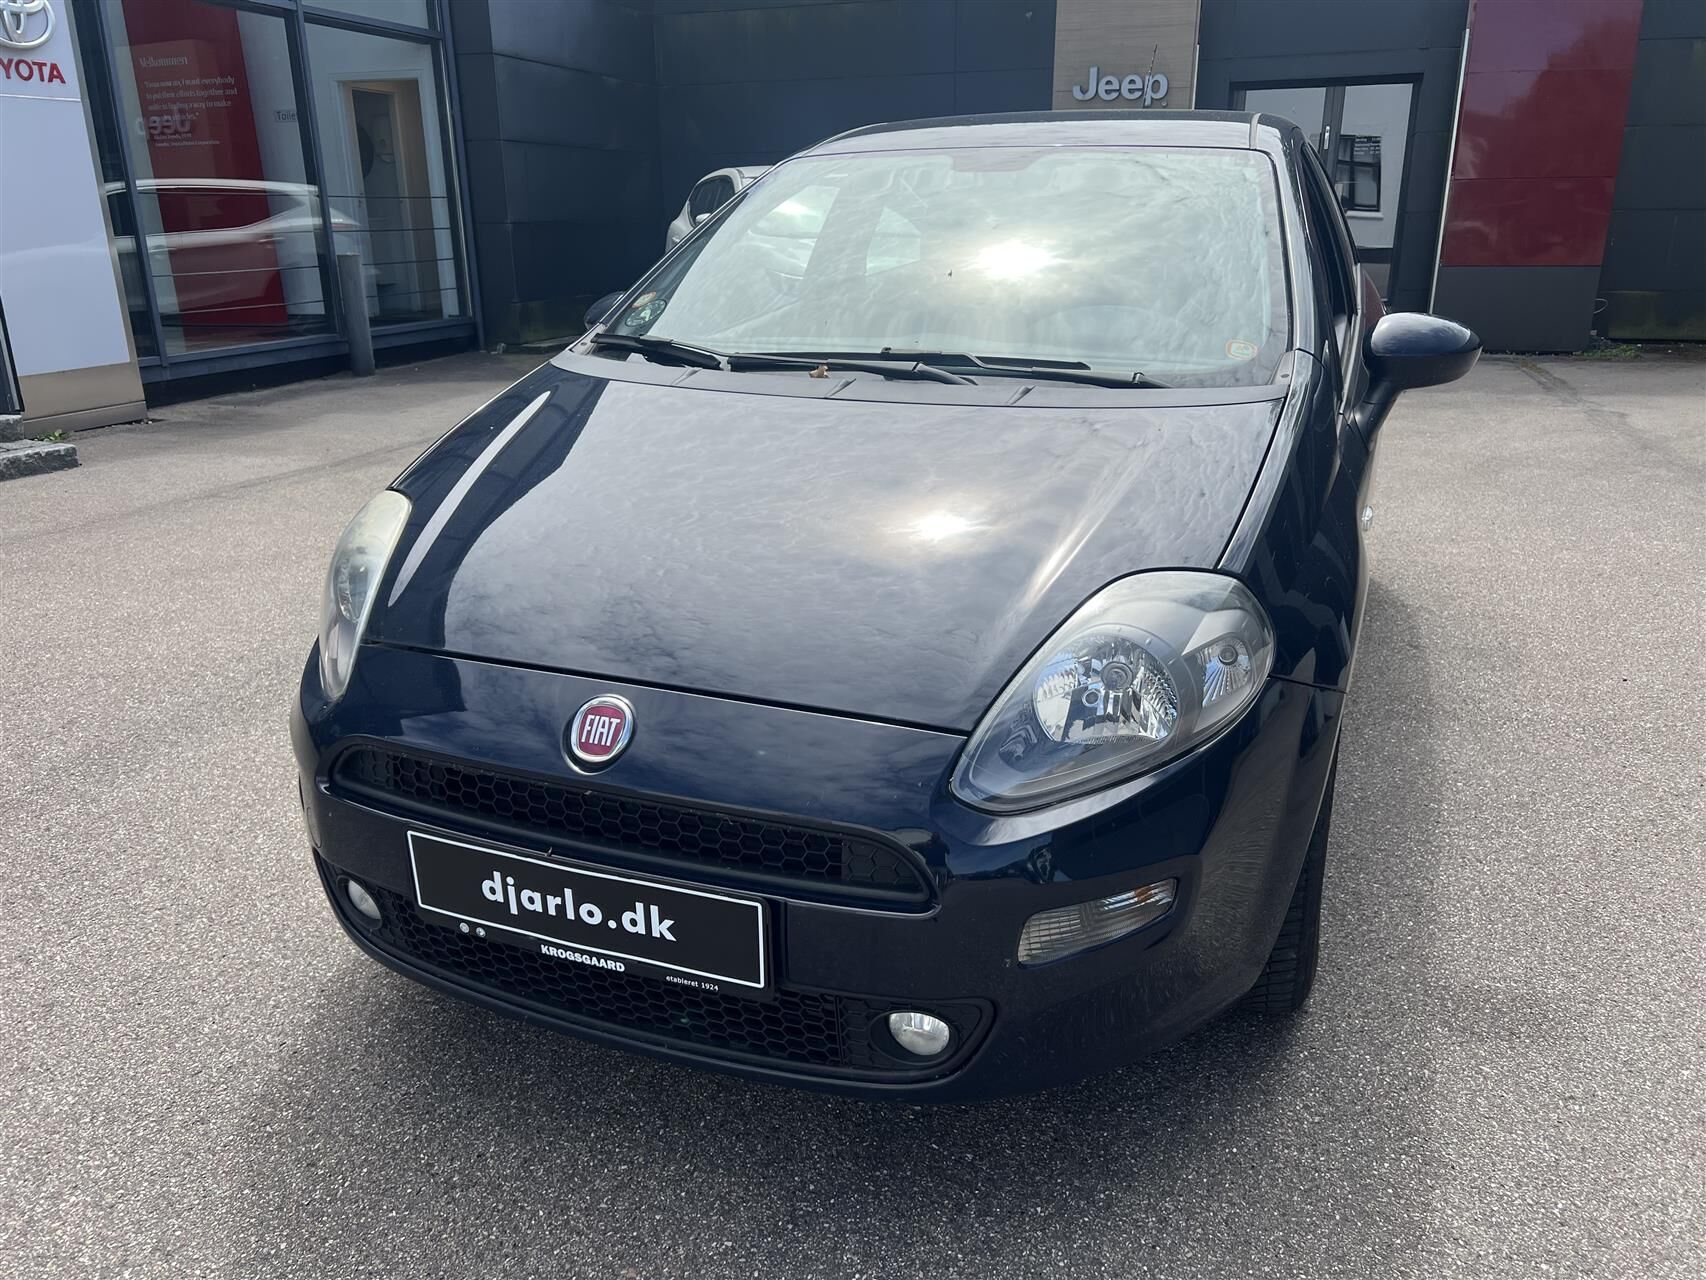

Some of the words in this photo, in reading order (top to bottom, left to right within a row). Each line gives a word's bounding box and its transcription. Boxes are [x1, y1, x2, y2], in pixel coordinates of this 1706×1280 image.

[1072, 66, 1168, 107] Jeep
[275, 110, 297, 121] Toile
[581, 714, 621, 747] FIAT
[481, 871, 677, 942] djarlo.dk
[541, 944, 625, 972] KROGSGAARD
[666, 975, 699, 988] etableret
[701, 982, 719, 992] 1924
